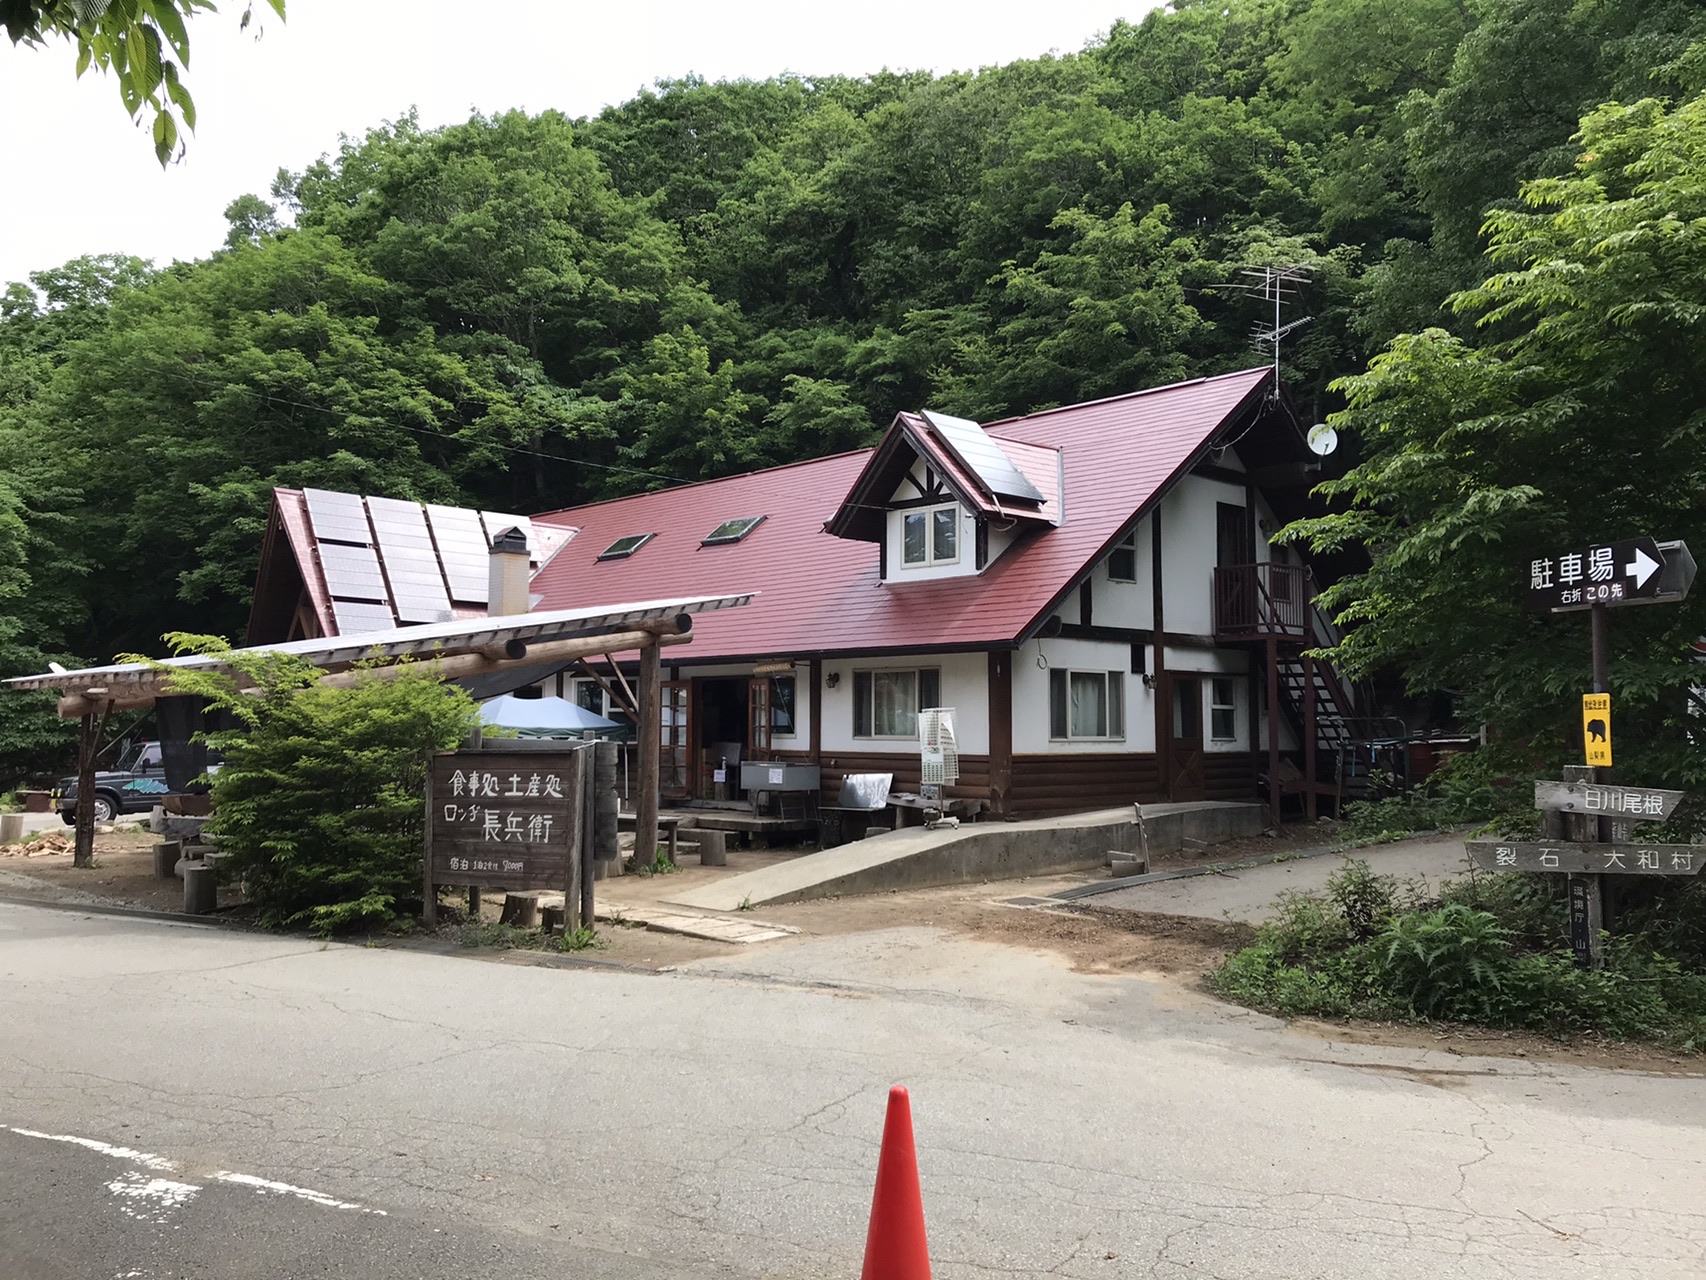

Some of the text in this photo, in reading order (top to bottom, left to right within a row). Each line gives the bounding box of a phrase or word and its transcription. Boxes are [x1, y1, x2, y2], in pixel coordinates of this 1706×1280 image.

[1530, 547, 1615, 590] 駐車場
[1561, 583, 1623, 604] 右折 この先
[448, 769, 564, 798] 食事処 土産処
[1585, 790, 1663, 815] 日川尾根
[482, 808, 553, 843] 長兵衛
[450, 857, 469, 871] 宿泊
[1603, 849, 1694, 870] 大和村
